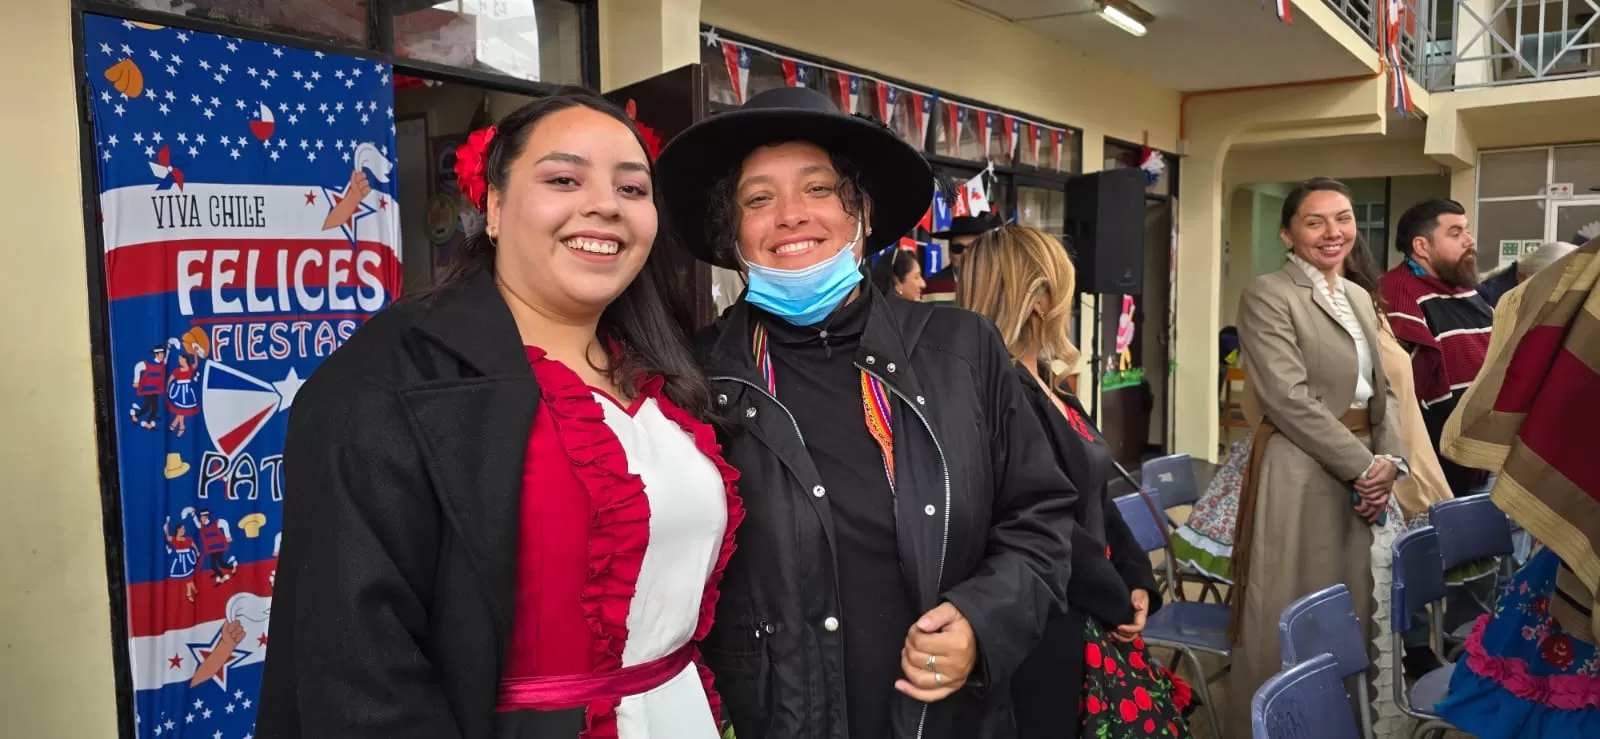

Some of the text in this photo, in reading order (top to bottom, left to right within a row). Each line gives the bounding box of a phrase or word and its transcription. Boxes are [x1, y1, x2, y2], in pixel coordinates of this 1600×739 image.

[151, 195, 266, 229] VIVA CHILE
[177, 248, 386, 316] FELICES
[211, 320, 356, 362] FIESTAS
